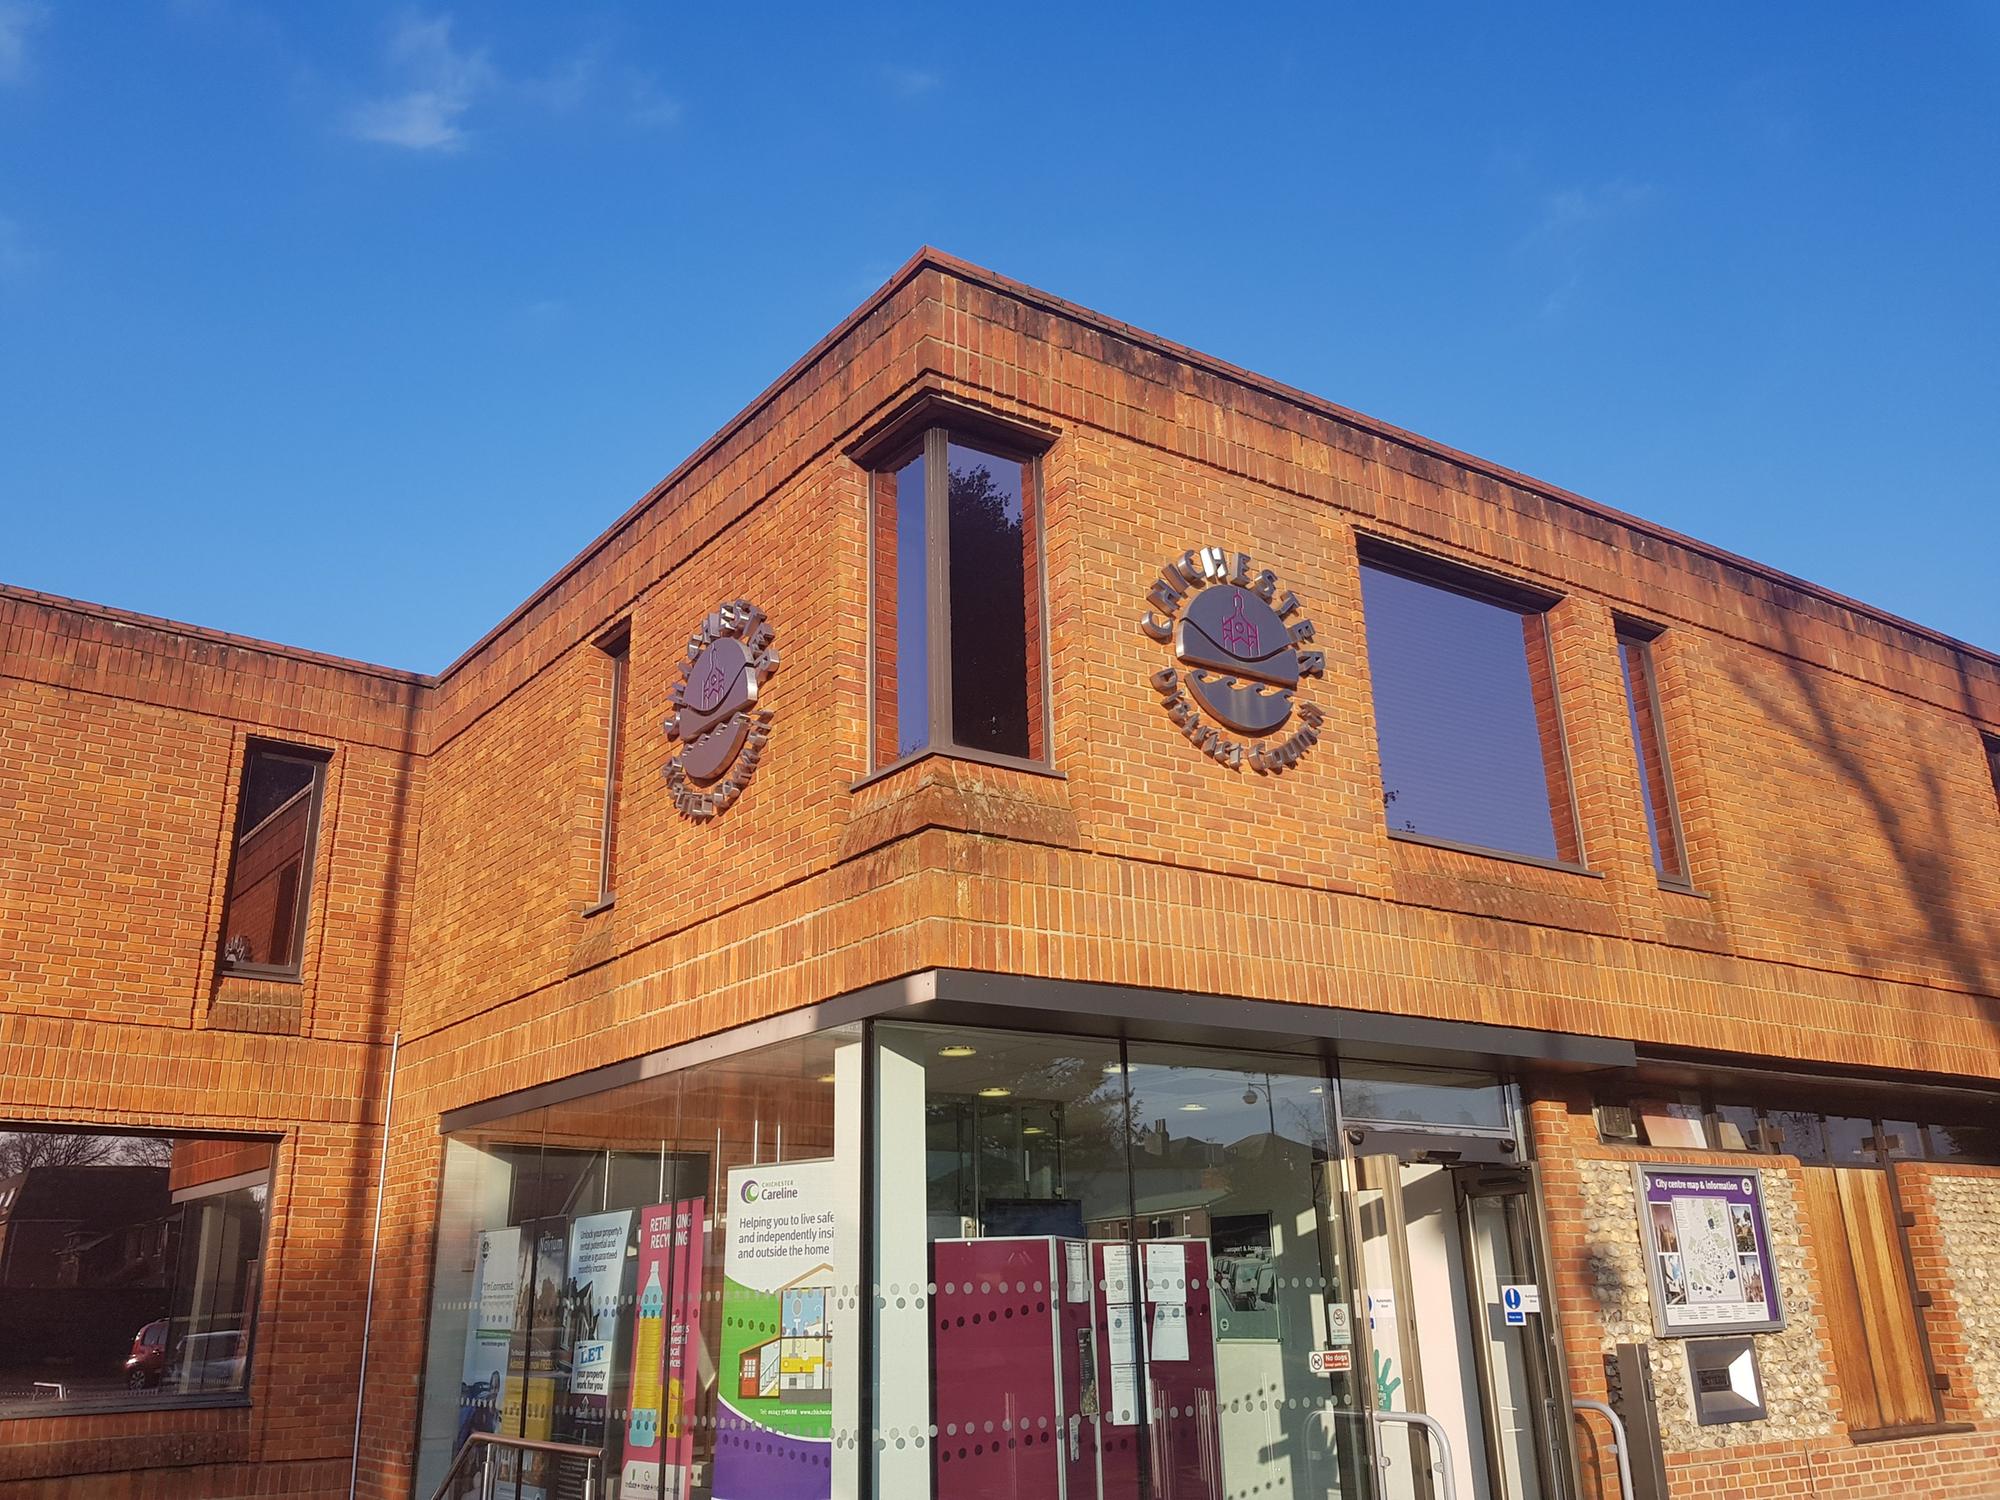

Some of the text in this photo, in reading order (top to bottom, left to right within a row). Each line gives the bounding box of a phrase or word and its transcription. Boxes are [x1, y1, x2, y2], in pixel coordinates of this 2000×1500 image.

[1141, 546, 1326, 676] CHICHESTER
[761, 1180, 794, 1188] CHICHESTER
[1655, 1178, 1738, 1191] City centre map & information
[761, 1187, 798, 1200] Careline
[740, 1216, 772, 1230] Helping
[773, 1217, 789, 1229] you
[790, 1215, 799, 1226] to
[800, 1213, 815, 1224] live
[739, 1227, 834, 1244] and independently insi
[738, 1244, 829, 1259] and outside the home
[581, 1345, 604, 1363] LET
[1334, 1353, 1348, 1362] dogs
[586, 1369, 606, 1381] property
[577, 1380, 587, 1389] work
[594, 1382, 603, 1392] you
